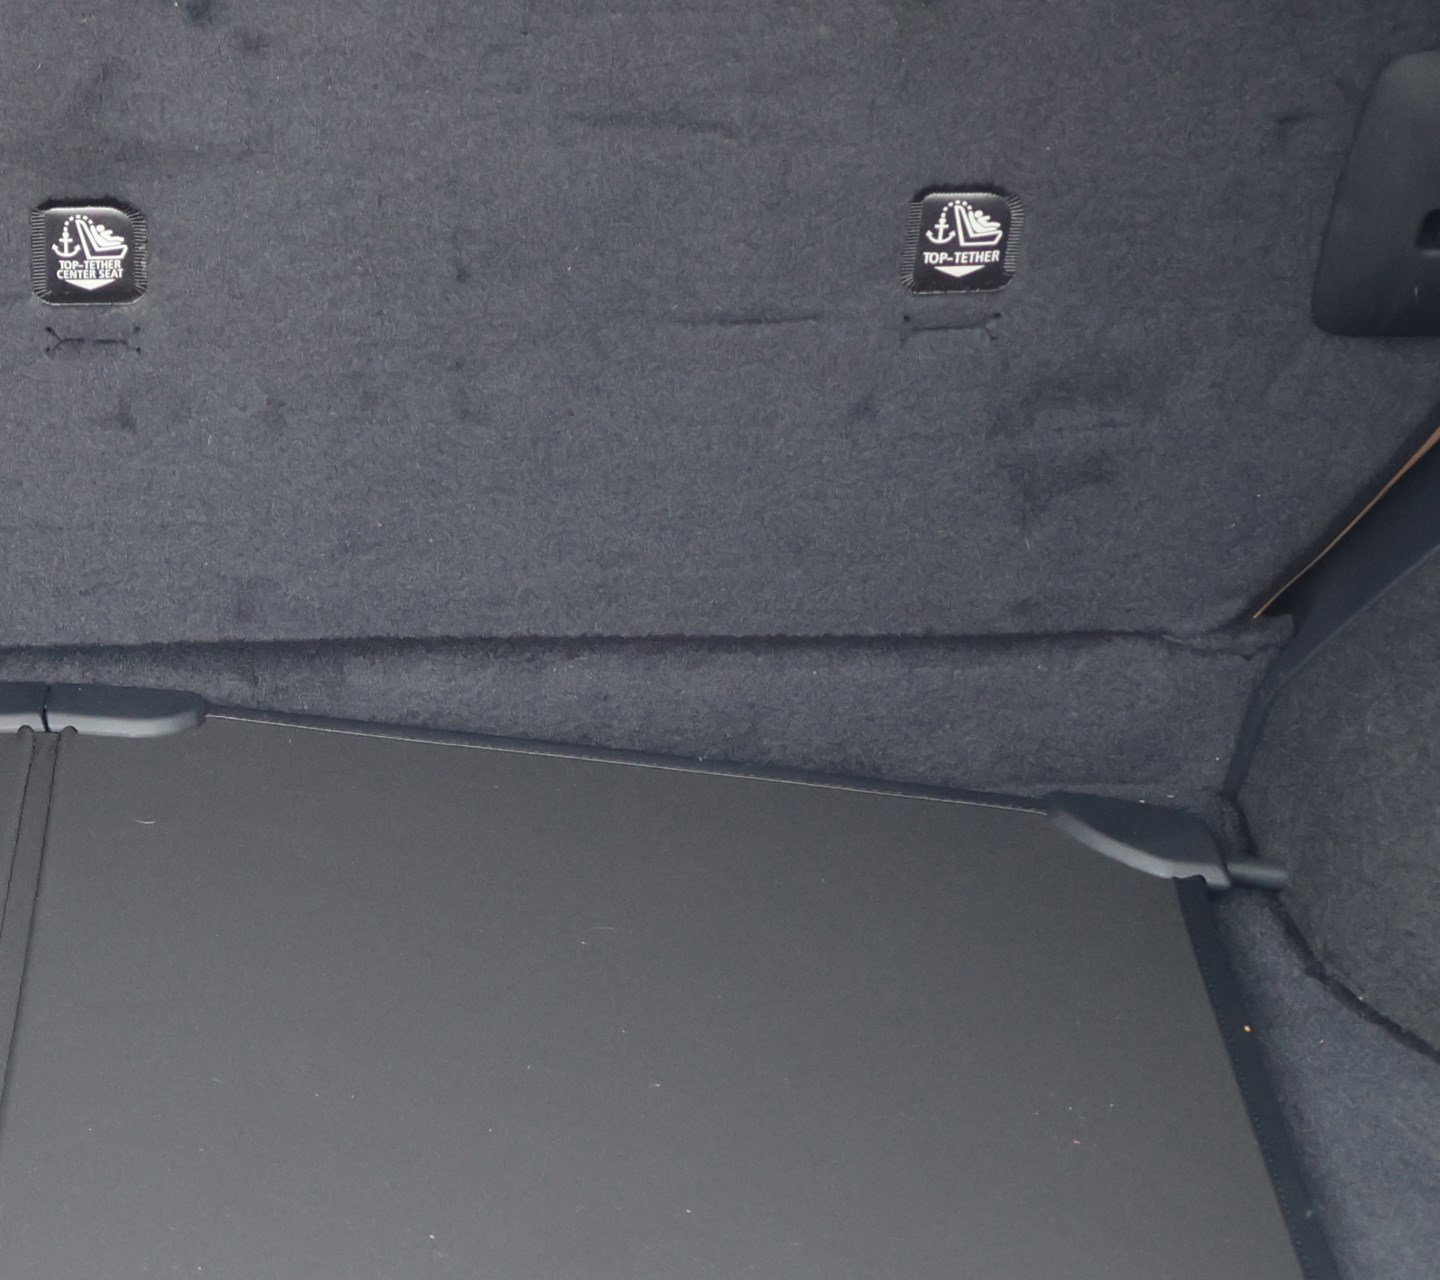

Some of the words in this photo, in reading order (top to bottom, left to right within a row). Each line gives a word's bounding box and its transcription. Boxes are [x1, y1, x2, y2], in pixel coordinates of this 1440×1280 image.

[923, 250, 1001, 265] TOP-TETHER
[58, 259, 122, 270] TOP-TETHER
[56, 269, 96, 280] CENTER
[98, 268, 124, 279] SEAT
